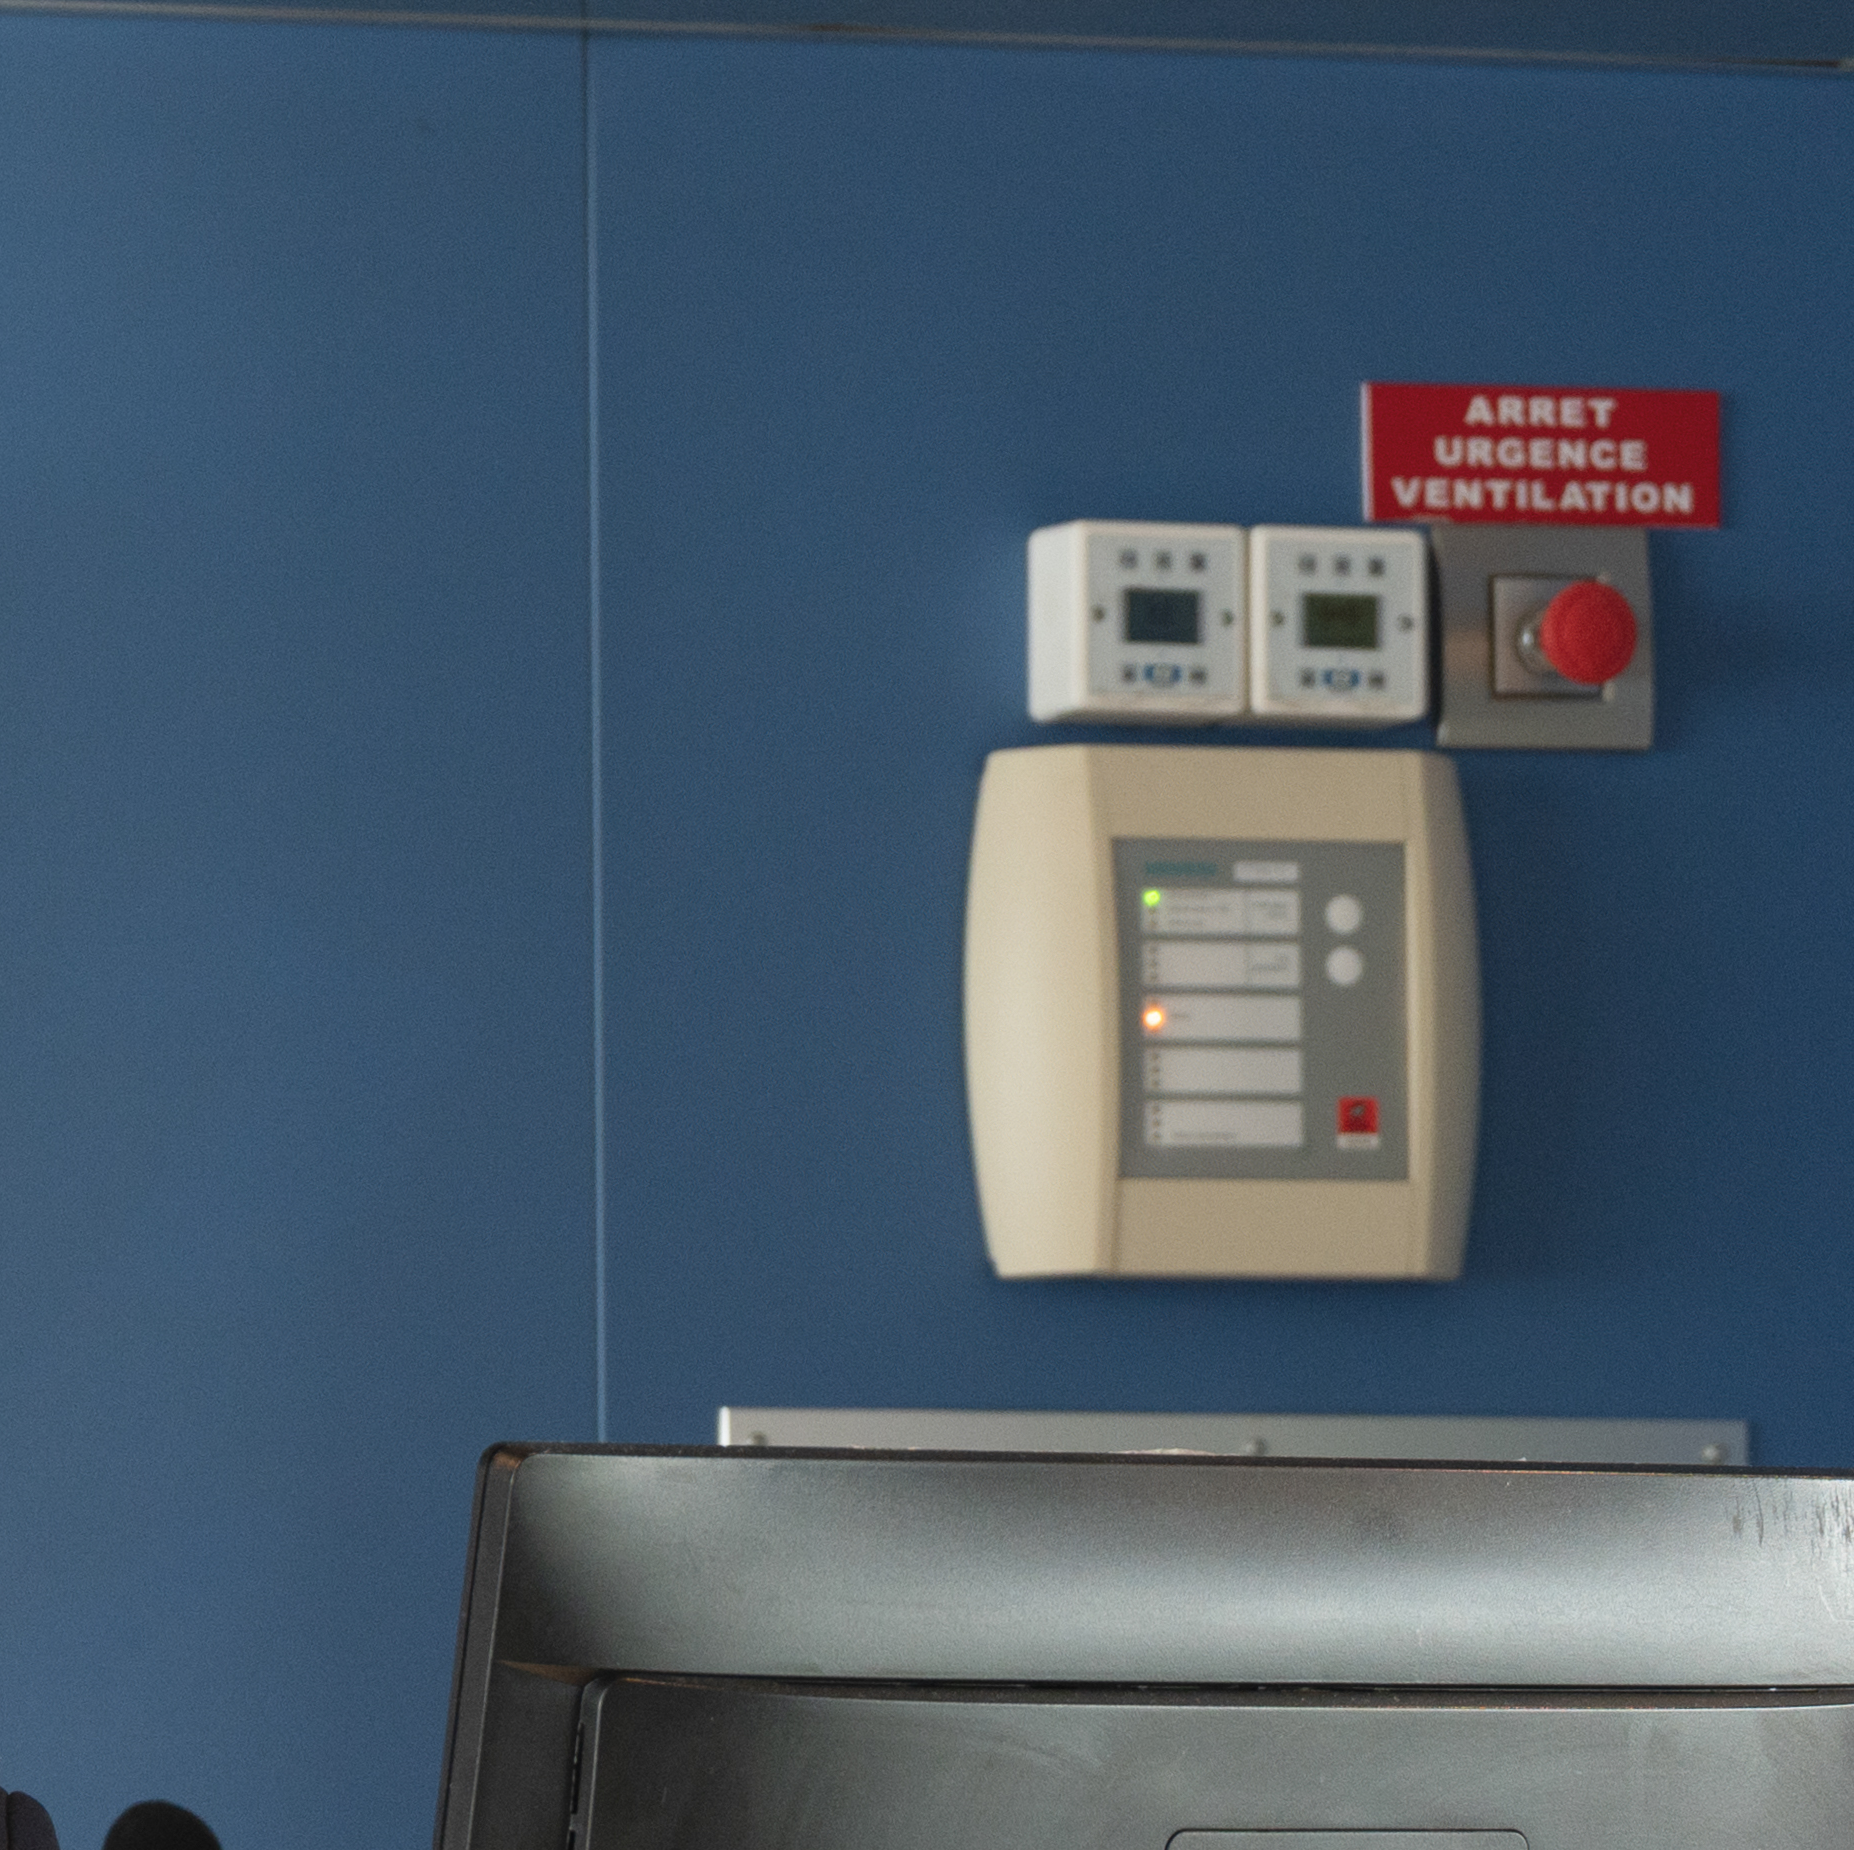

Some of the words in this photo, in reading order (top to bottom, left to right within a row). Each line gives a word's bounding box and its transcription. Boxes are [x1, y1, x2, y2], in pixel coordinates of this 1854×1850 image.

[1464, 395, 1617, 428] ARRET
[1434, 435, 1648, 472] URGENCE
[1391, 476, 1694, 513] VENTILATION
